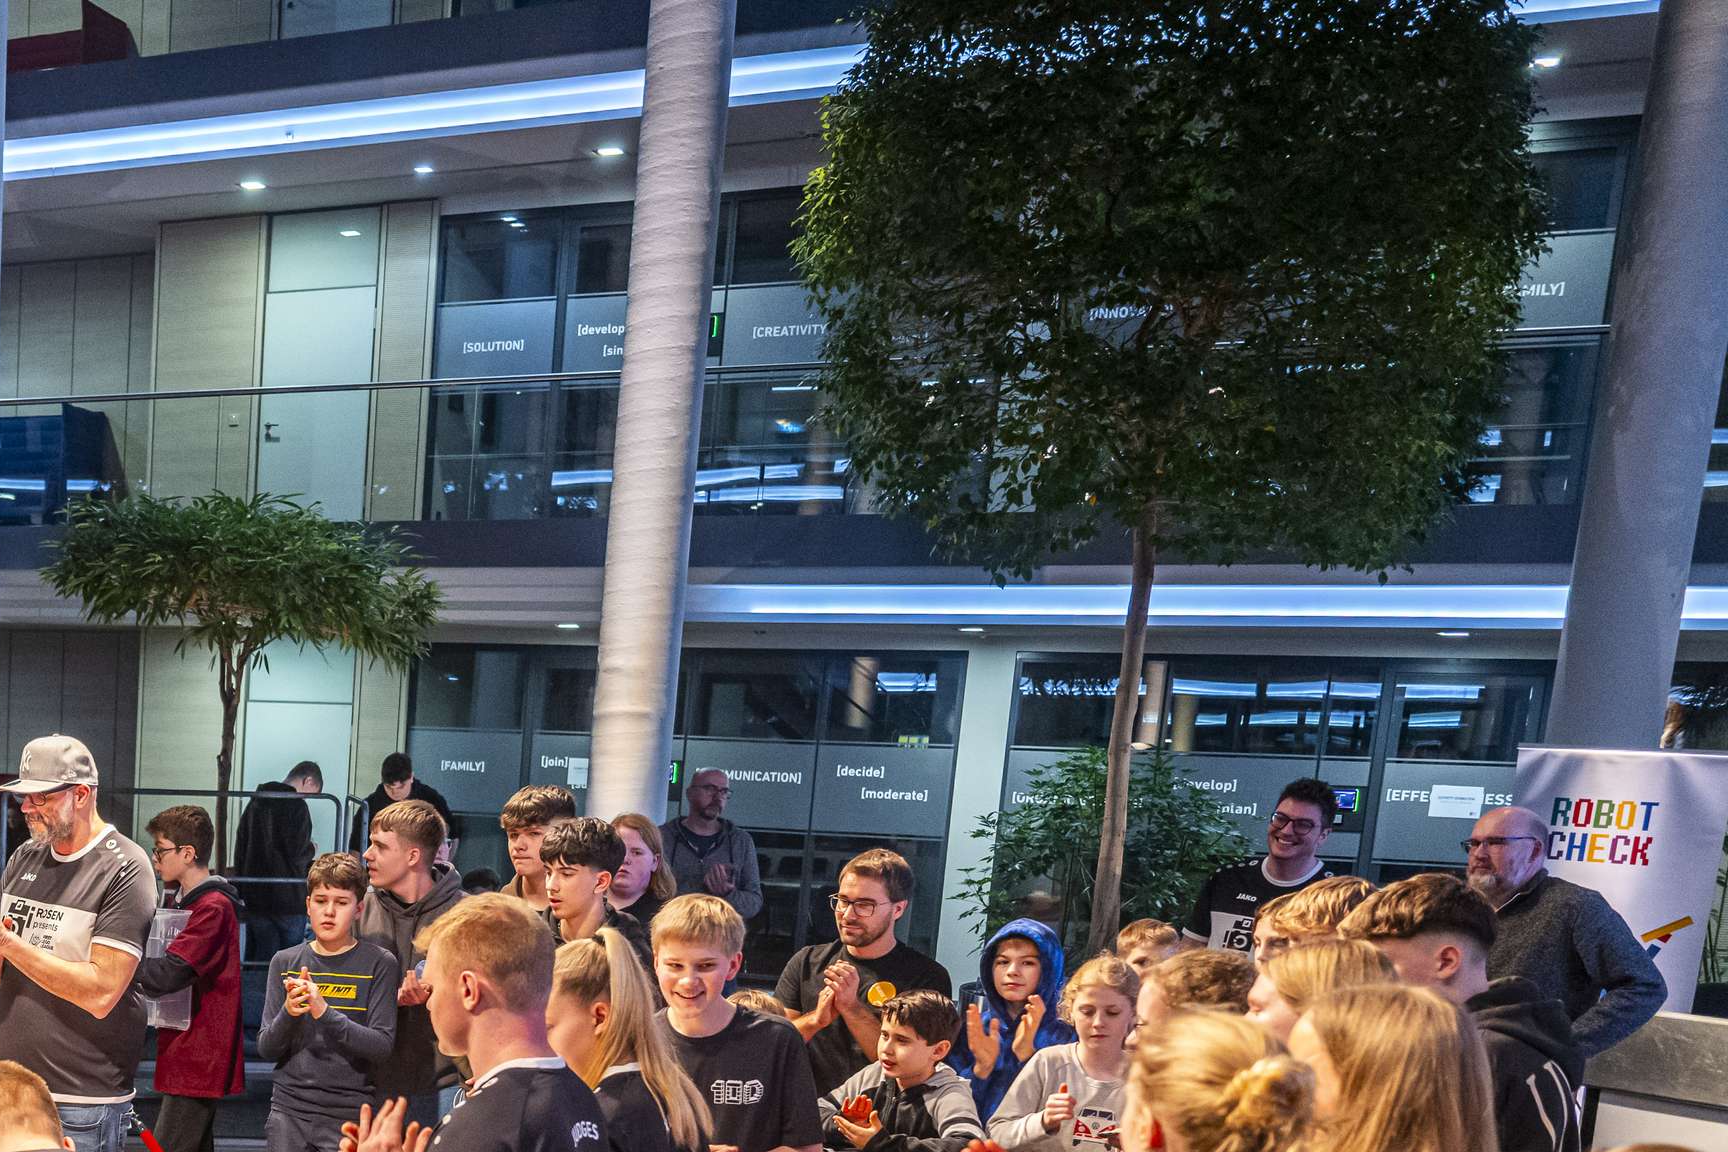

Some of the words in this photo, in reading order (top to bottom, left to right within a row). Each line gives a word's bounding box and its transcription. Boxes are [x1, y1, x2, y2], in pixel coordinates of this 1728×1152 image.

[1503, 281, 1566, 298] MILY]
[577, 323, 625, 336] [develop
[752, 323, 829, 340] [CREATIVITY
[463, 339, 525, 354] [SOLUTION]
[602, 344, 624, 357] [sin
[441, 760, 485, 773] [FAMILY]
[541, 755, 569, 768] [join]
[836, 764, 885, 779] [decide]
[1173, 776, 1238, 793] velop]
[860, 786, 929, 802] [moderate]
[1550, 797, 1660, 831] ROBOT
[1547, 831, 1653, 866] CHECK
[1236, 892, 1257, 902] JAKO
[36, 908, 64, 921] ROSEN
